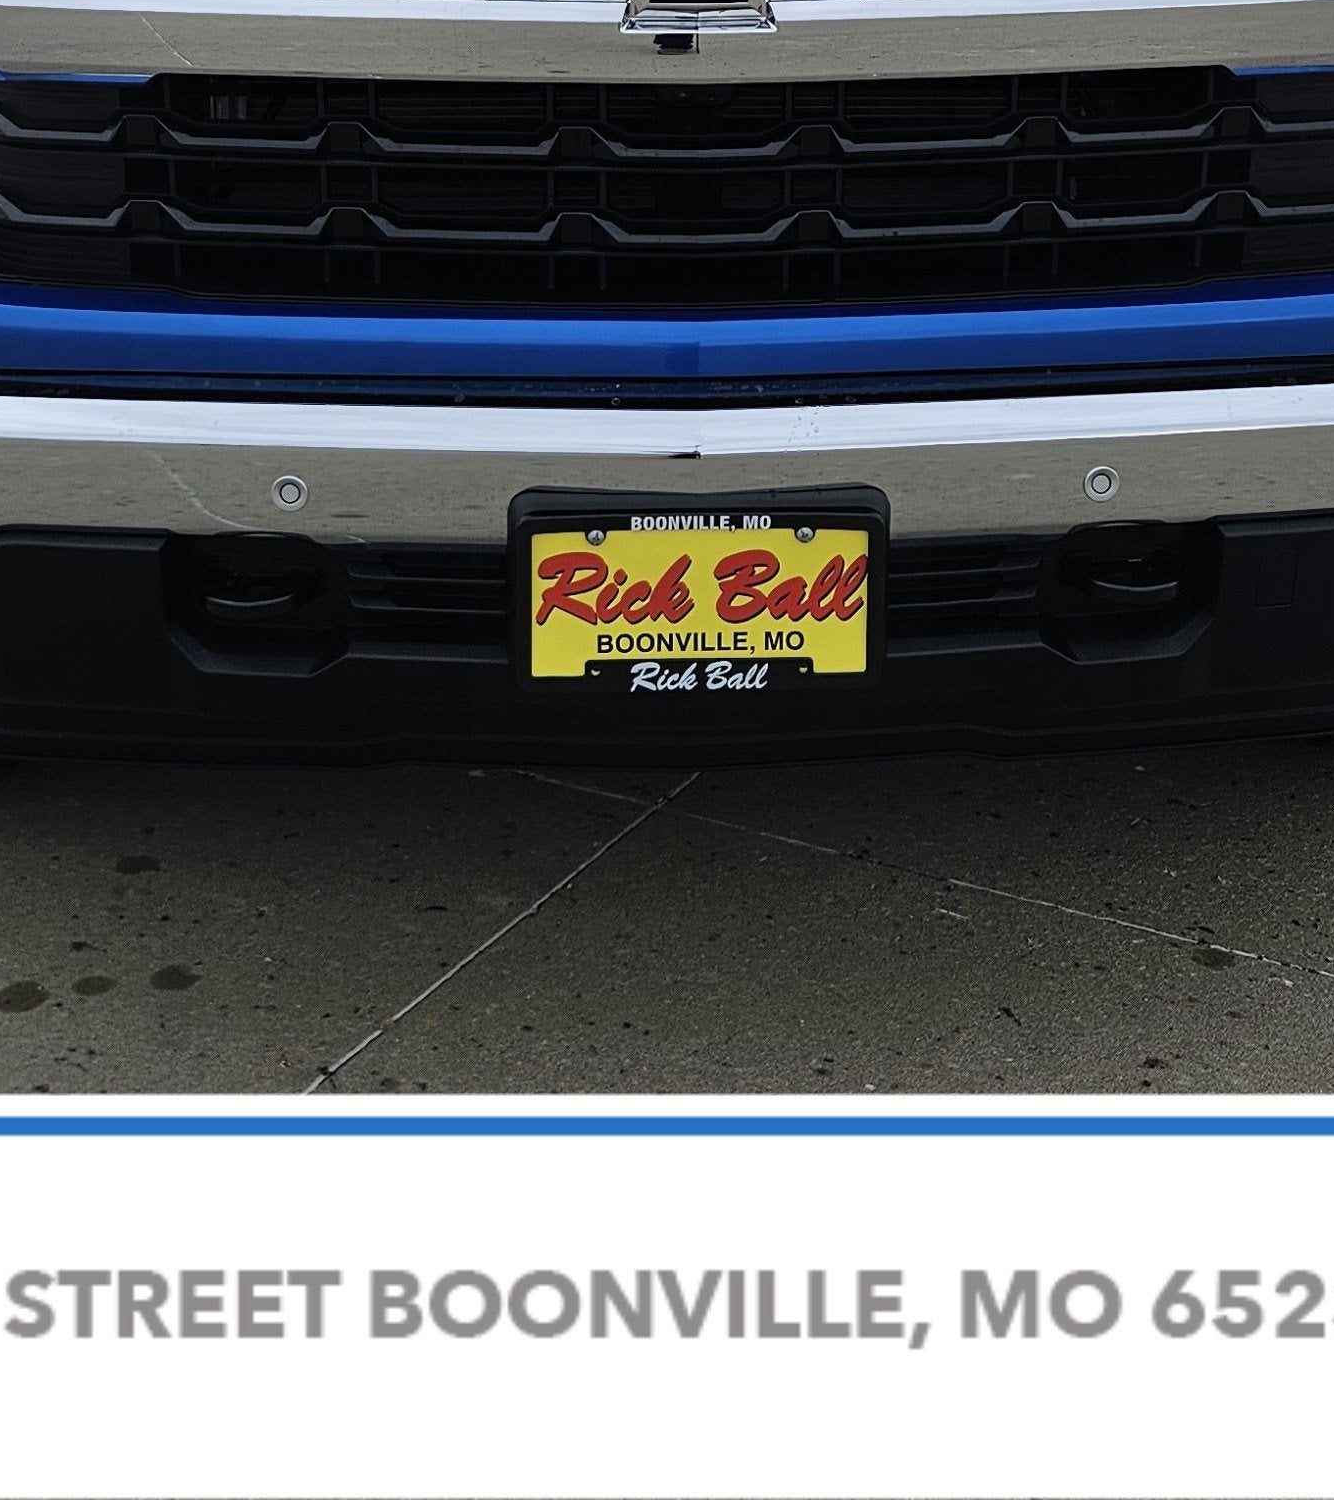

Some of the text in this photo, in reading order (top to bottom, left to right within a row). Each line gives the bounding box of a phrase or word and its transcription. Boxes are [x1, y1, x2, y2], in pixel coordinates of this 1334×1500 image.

[630, 514, 772, 532] BOONVILLE, MO
[535, 548, 868, 626] Rick Ball
[596, 630, 805, 656] BOONVILLE, MO
[630, 660, 769, 693] Rick Ball
